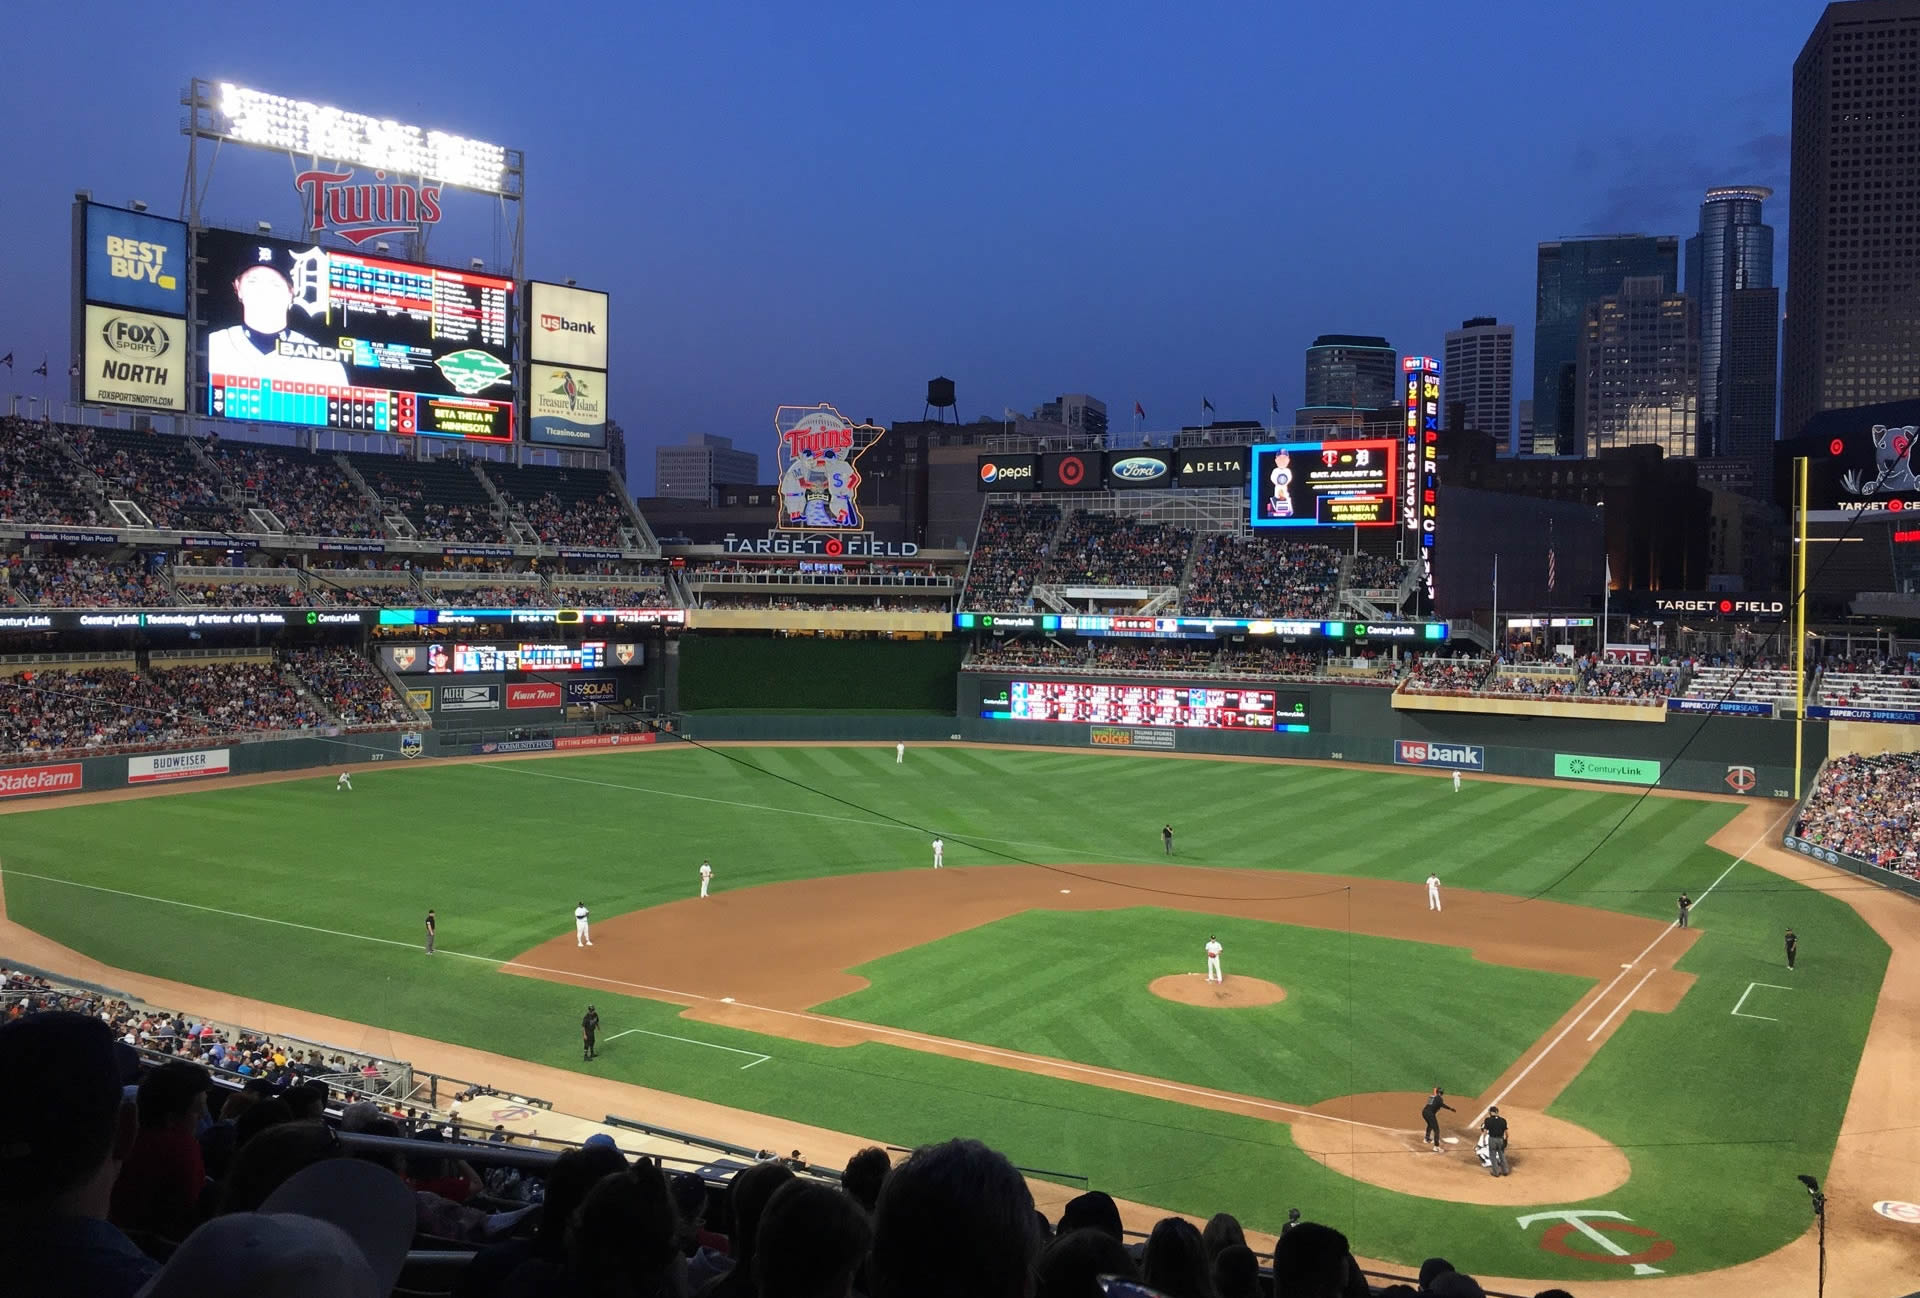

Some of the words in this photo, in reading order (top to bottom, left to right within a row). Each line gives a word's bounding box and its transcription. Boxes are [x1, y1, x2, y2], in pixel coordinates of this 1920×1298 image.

[296, 170, 442, 232] Twins
[107, 235, 167, 265] BEST
[111, 256, 163, 283] BUY
[117, 322, 155, 345] FOX
[116, 340, 156, 353] SPORTS
[280, 341, 352, 362] BANDIT
[102, 360, 168, 385] NORTH
[1424, 375, 1440, 385] GATE
[98, 390, 173, 406] FOXSPORTSNORTH.COM
[1424, 383, 1440, 399] 34
[538, 394, 569, 409] Treasure
[577, 398, 598, 412] Island
[1408, 373, 1417, 450] EXPERIENCE
[441, 421, 491, 433] MINNESOTA
[784, 425, 854, 460] Twins
[999, 464, 1031, 480] pepsi
[1122, 462, 1155, 477] Ford
[1197, 461, 1240, 473] DELTA
[1423, 402, 1438, 546] EXPERIENCE
[833, 473, 844, 488] S
[1407, 468, 1416, 504] GATE
[1838, 502, 1887, 510] TARGET
[724, 538, 822, 553] TARGET
[848, 541, 918, 556] FIELD
[1656, 600, 1716, 612] TARGET
[1735, 601, 1783, 612] FIELD
[80, 615, 138, 627] CenturyLink
[146, 614, 197, 626] Technology
[199, 614, 230, 623] Partner
[232, 614, 243, 623] of
[244, 614, 257, 623] the
[318, 614, 360, 623] CenturyLink
[994, 616, 1034, 626] CenturyLink
[1367, 626, 1414, 635] CenturyLink
[1681, 702, 1718, 710] SUPERCUTS
[1720, 704, 1759, 712] SUPERSEATS
[1829, 709, 1870, 718] SUPERCUTS
[1872, 712, 1916, 720] SUPERSEATS
[1093, 736, 1129, 744] VOICES
[154, 754, 206, 769] BUDWEISER
[1588, 764, 1641, 776] CenturyLink
